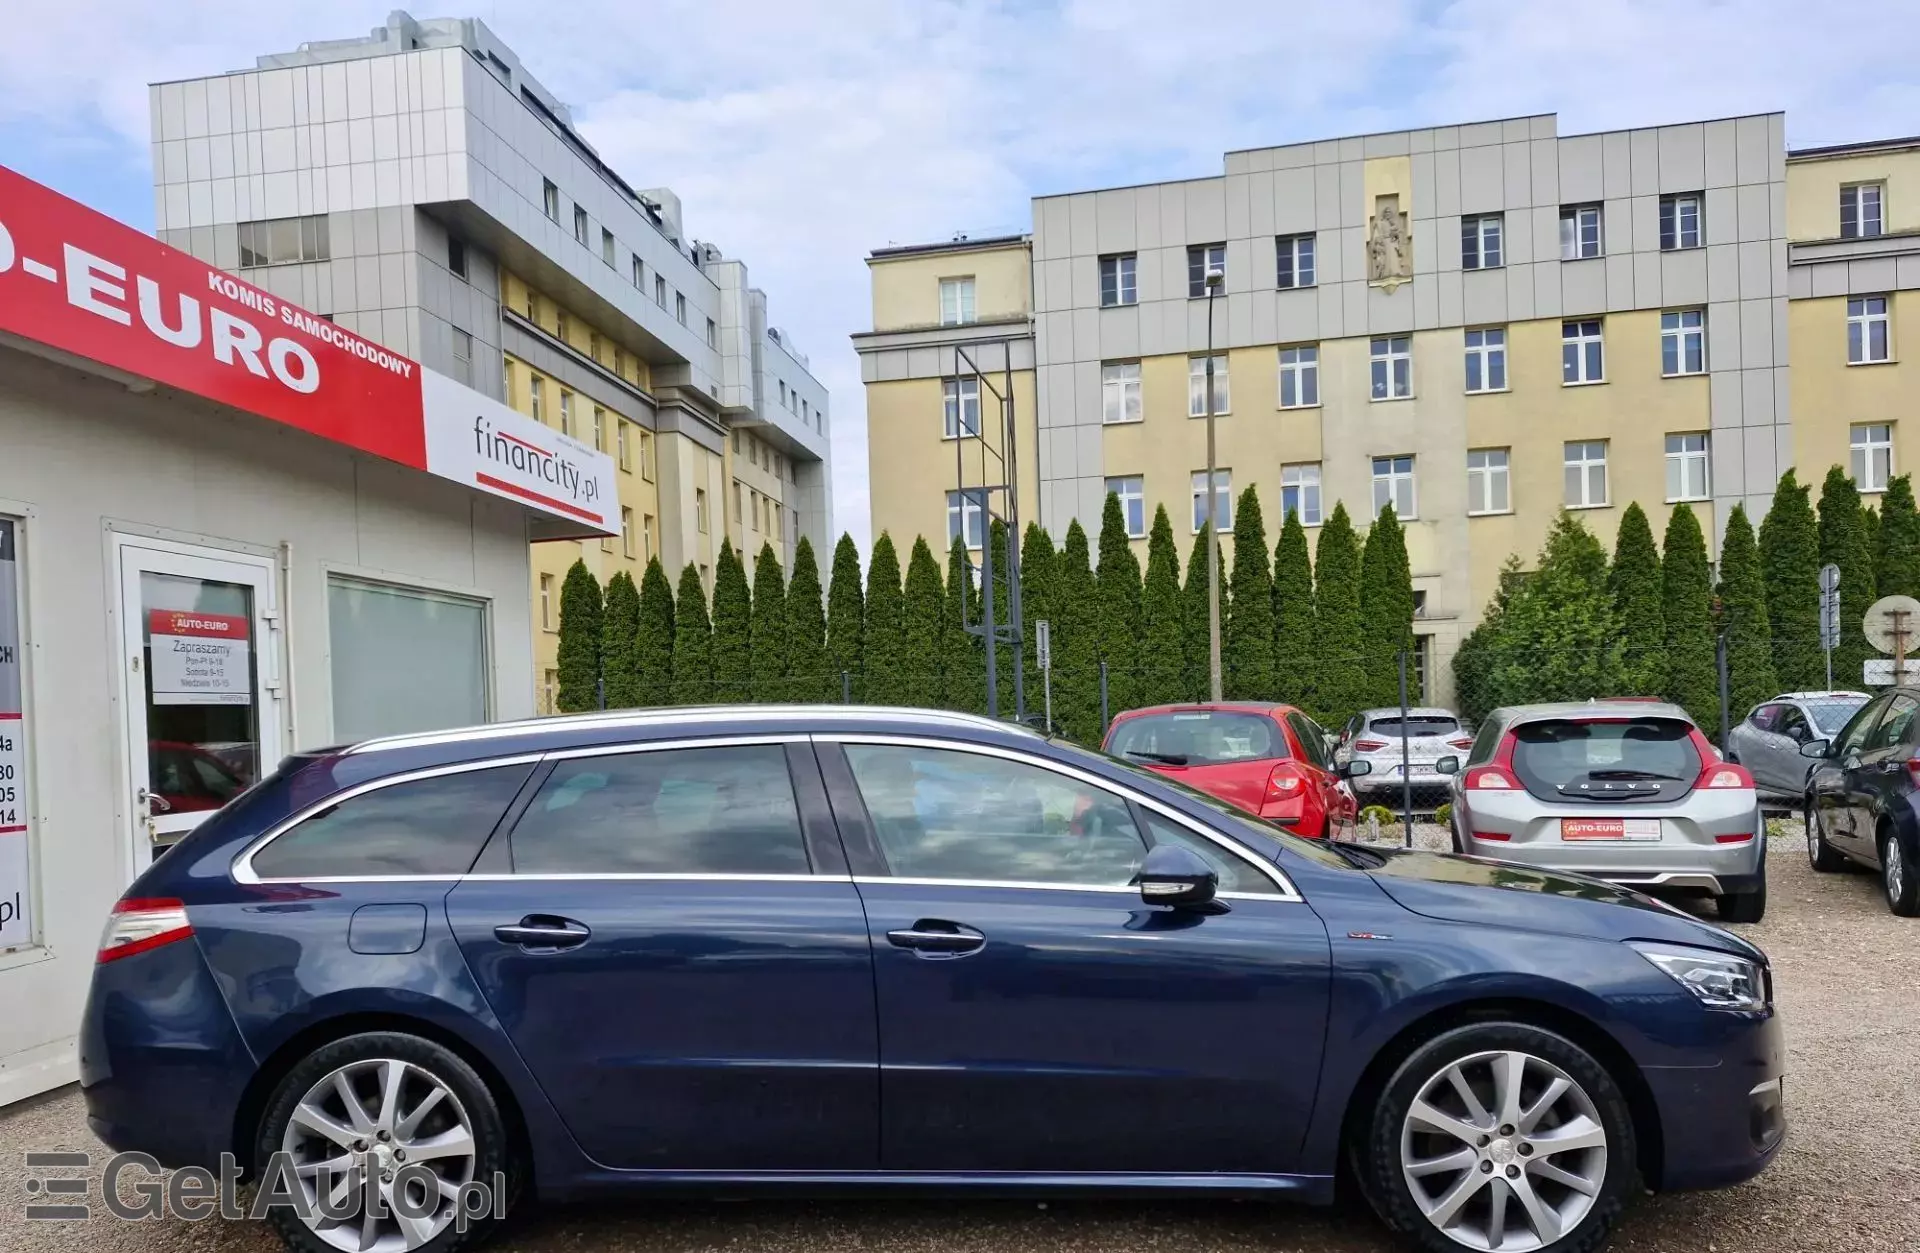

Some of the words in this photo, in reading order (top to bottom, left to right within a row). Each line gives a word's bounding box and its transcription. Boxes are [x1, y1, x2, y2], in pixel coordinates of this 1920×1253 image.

[0, 220, 320, 394] -EURO
[207, 271, 276, 317] KOMIS
[280, 305, 412, 379] SAMOCHODOWY
[473, 415, 599, 502] financity.pl
[173, 640, 231, 657] Zapraszamy
[176, 618, 229, 631] AUTO-EURO
[1568, 824, 1624, 832] AUTO-EURO
